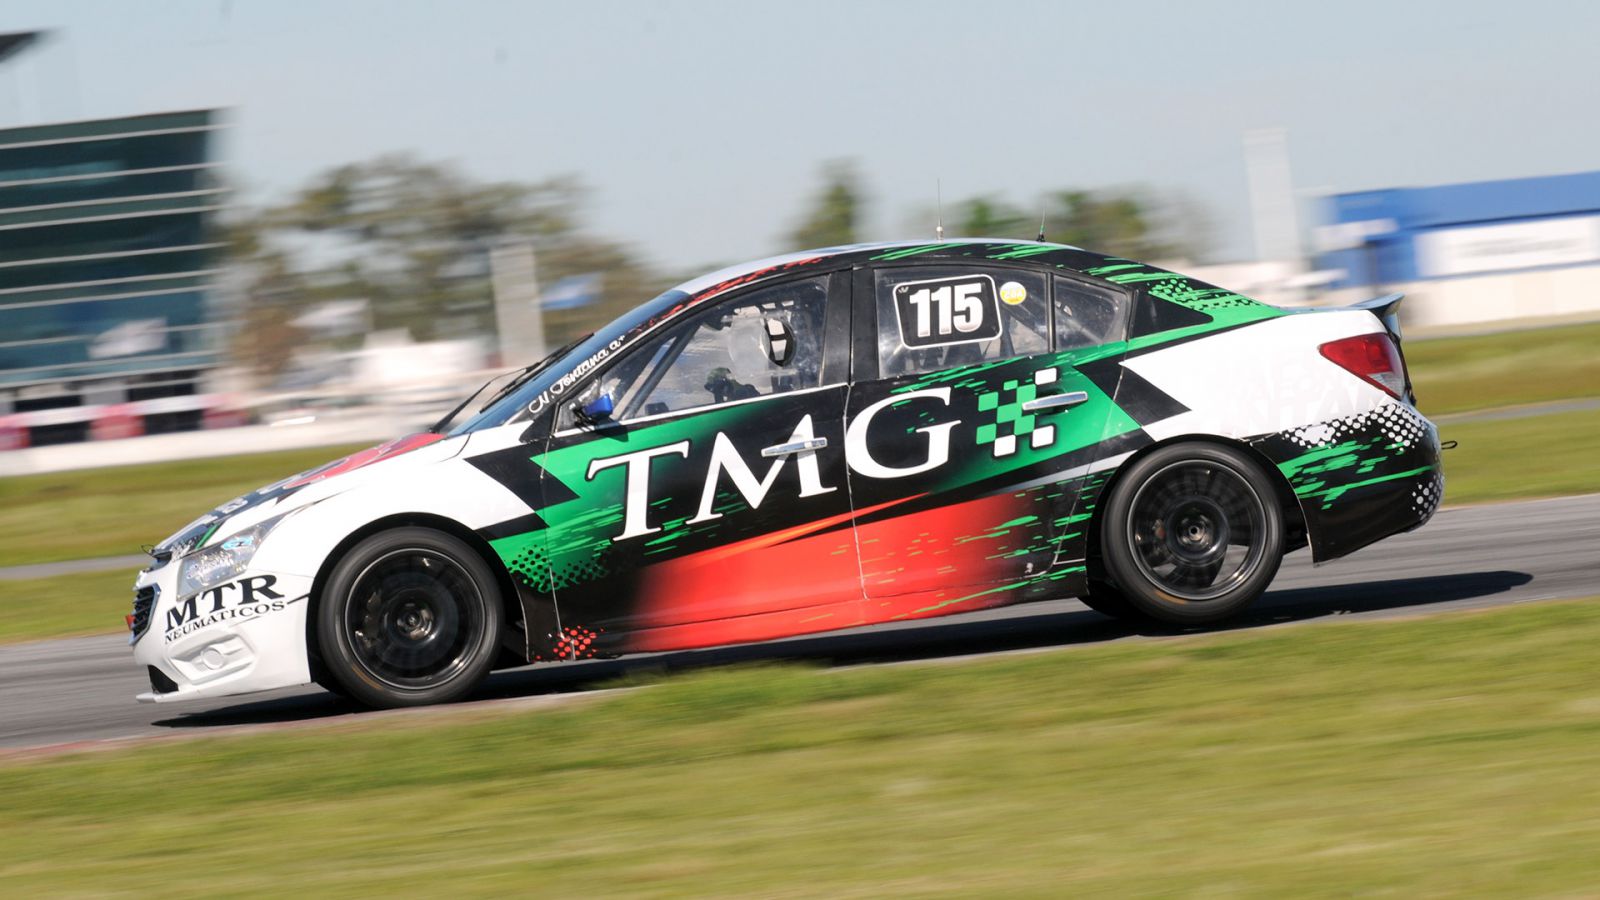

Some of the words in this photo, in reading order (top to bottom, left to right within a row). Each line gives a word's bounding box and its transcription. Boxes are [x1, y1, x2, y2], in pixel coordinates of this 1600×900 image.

[909, 283, 983, 338] 115
[586, 386, 962, 541] TMG
[165, 574, 285, 632] MTR
[165, 600, 285, 645] NEUMATICOS
